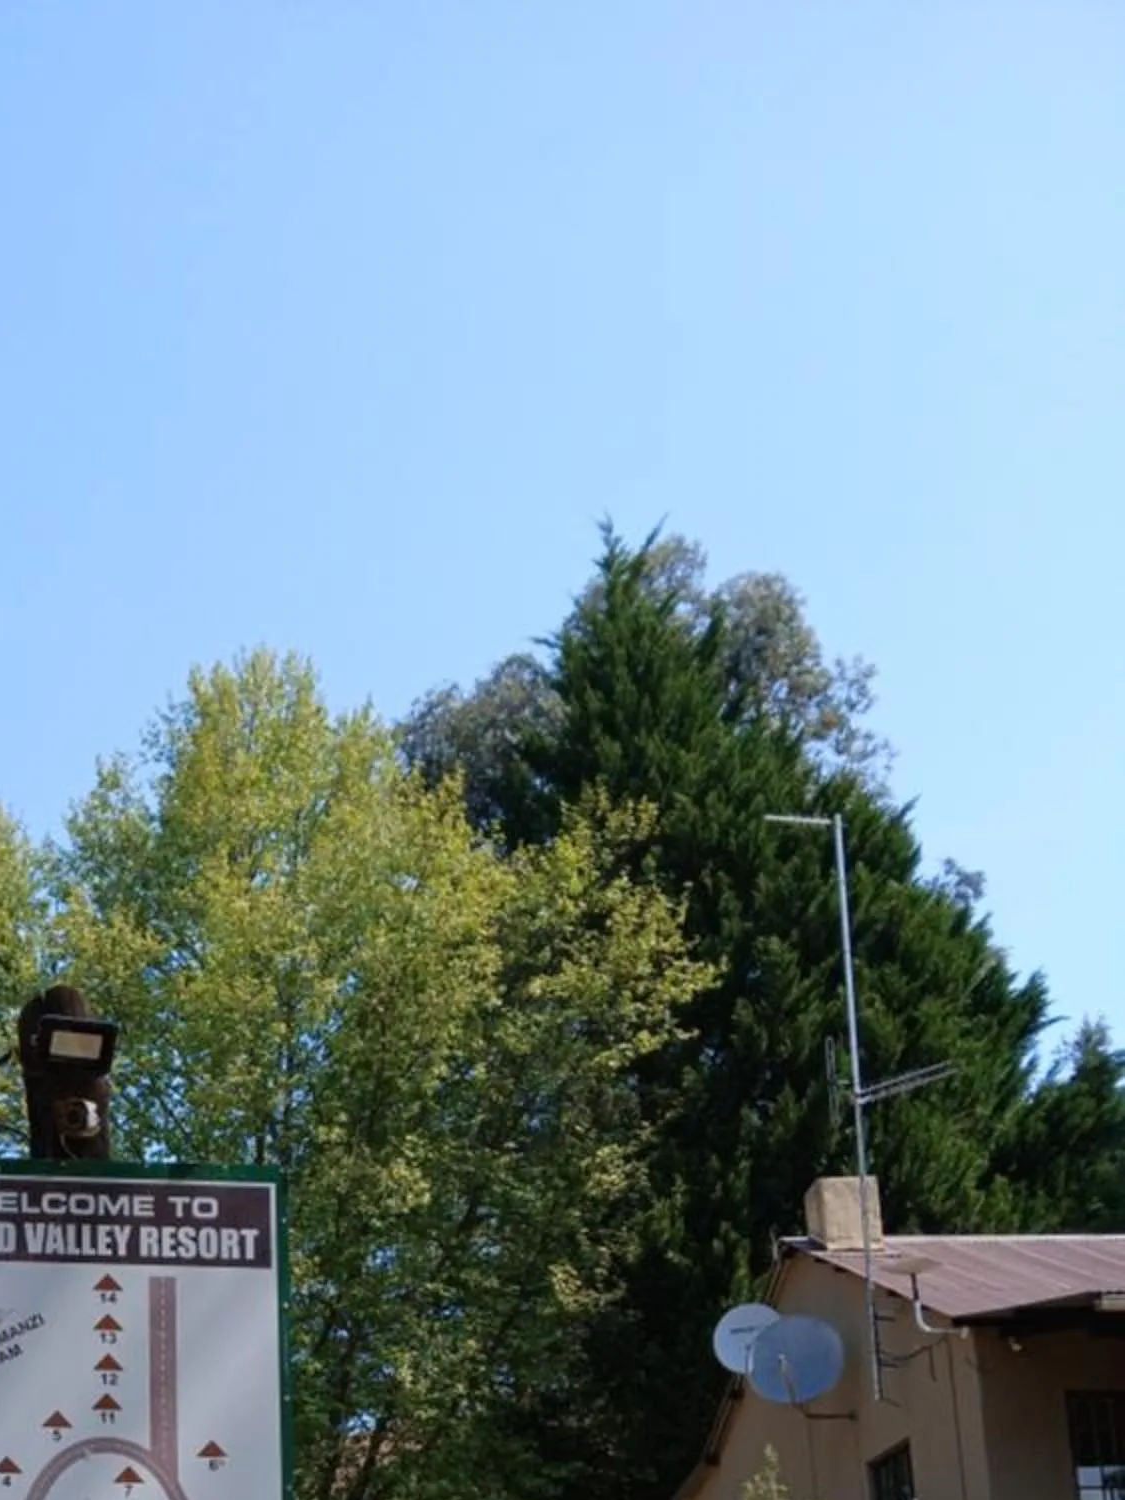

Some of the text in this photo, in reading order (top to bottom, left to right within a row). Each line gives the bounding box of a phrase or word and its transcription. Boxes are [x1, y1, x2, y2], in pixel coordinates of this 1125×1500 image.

[166, 1196, 220, 1219] TO
[24, 1223, 131, 1257] VALLEY
[139, 1227, 260, 1260] RESORT
[99, 1292, 118, 1303] 14
[99, 1333, 117, 1344] 13
[100, 1374, 119, 1385] 12
[100, 1413, 117, 1424] 11
[122, 1485, 132, 1498] 7
